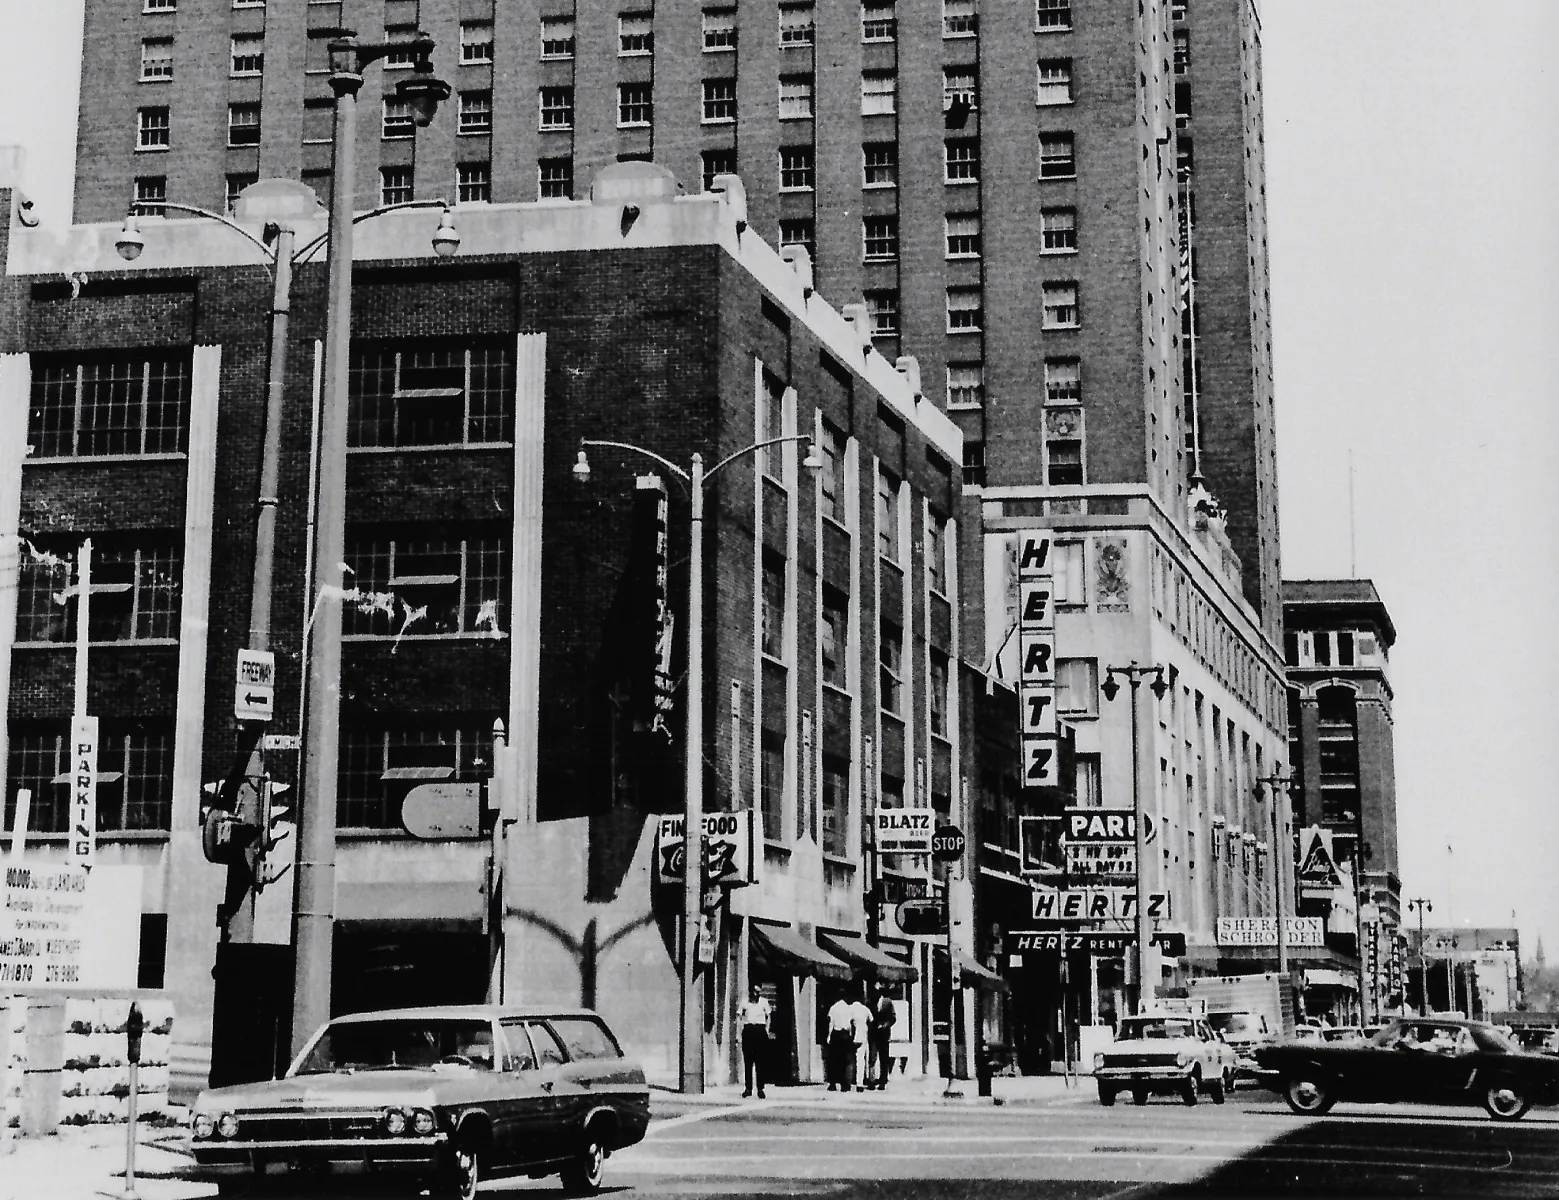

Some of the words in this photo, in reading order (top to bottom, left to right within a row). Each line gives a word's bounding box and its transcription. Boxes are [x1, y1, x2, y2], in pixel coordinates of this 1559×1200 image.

[1021, 538, 1053, 779] HERTZ
[242, 660, 273, 683] FREEWAY
[76, 743, 92, 856] PARKING
[661, 819, 685, 838] FIN
[878, 814, 930, 829] BLATZ
[933, 836, 964, 851] STOP
[1035, 894, 1166, 918] HERTZ
[1090, 939, 1123, 949] RENT
[1220, 931, 1322, 943] SCHRODER
